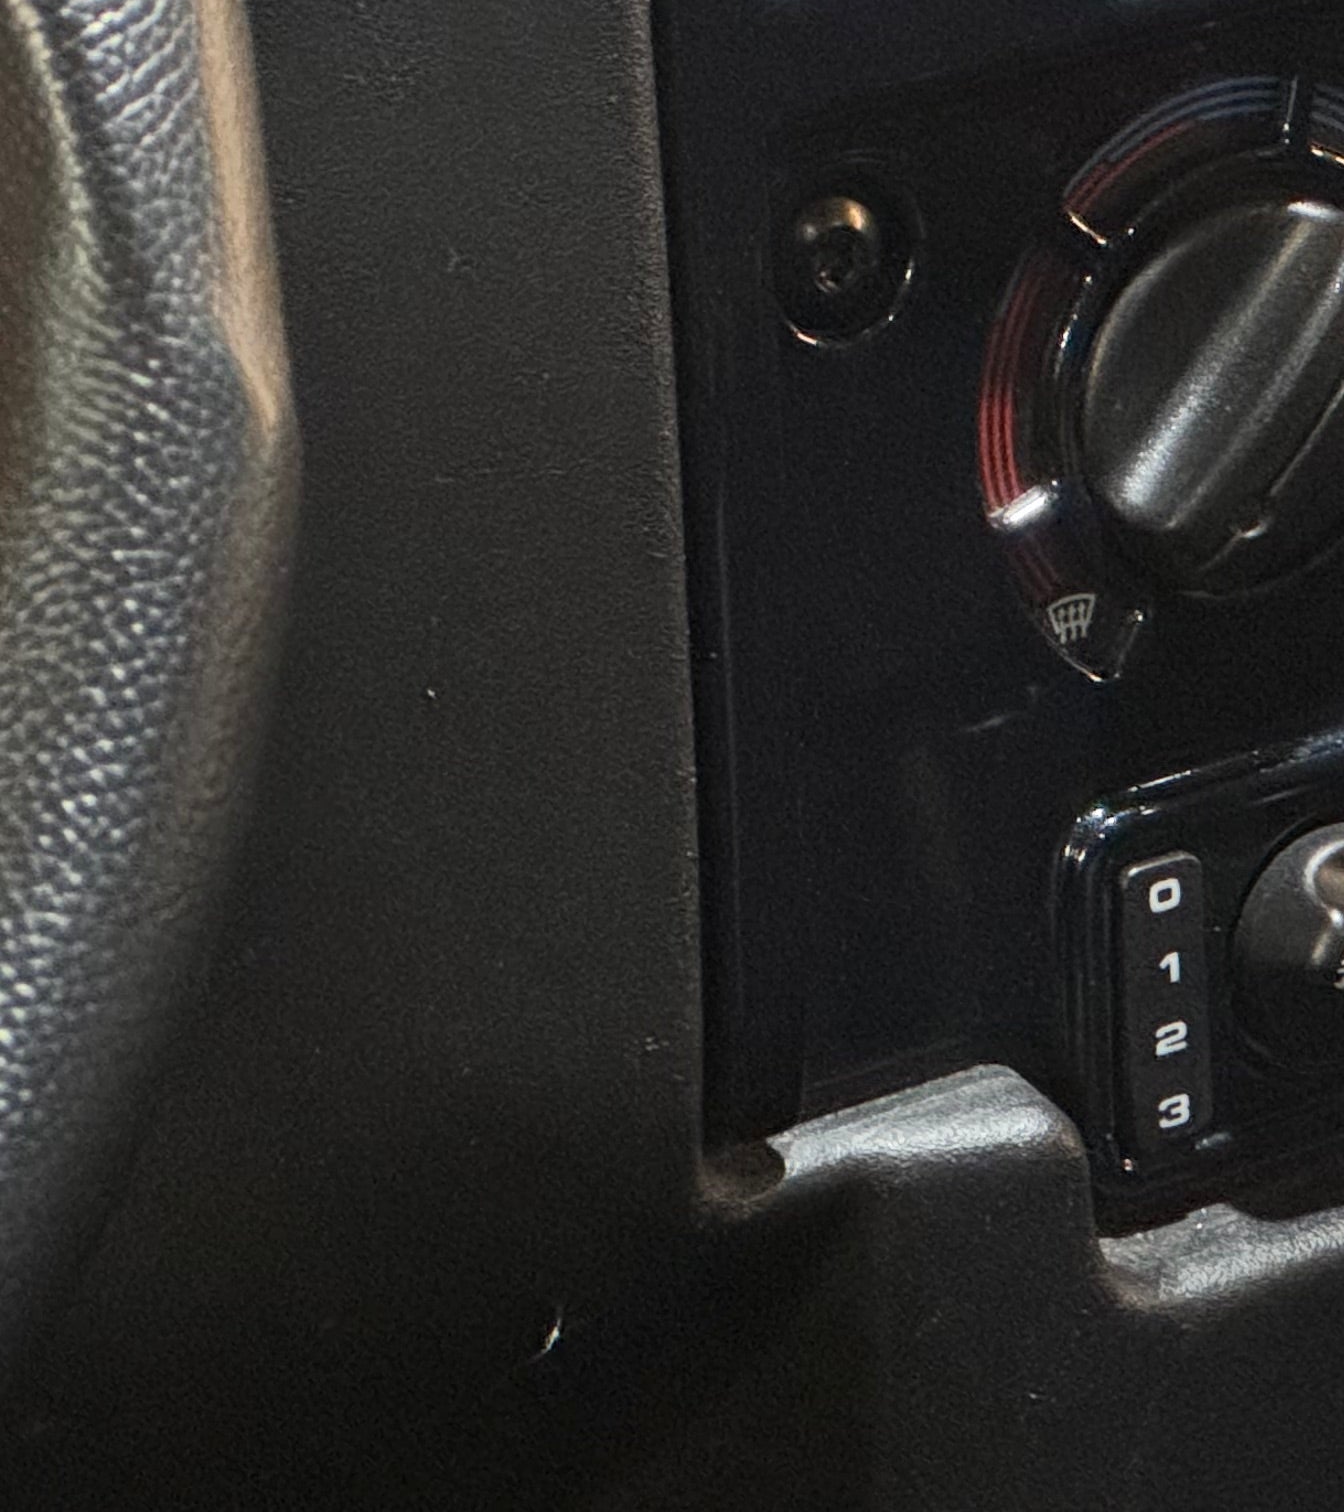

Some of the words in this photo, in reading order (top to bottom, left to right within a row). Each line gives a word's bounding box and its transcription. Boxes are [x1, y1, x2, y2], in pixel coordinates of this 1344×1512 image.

[1149, 877, 1182, 914] 0
[1158, 951, 1181, 984] 1
[1155, 1020, 1189, 1057] 2
[1157, 1093, 1191, 1129] 3
